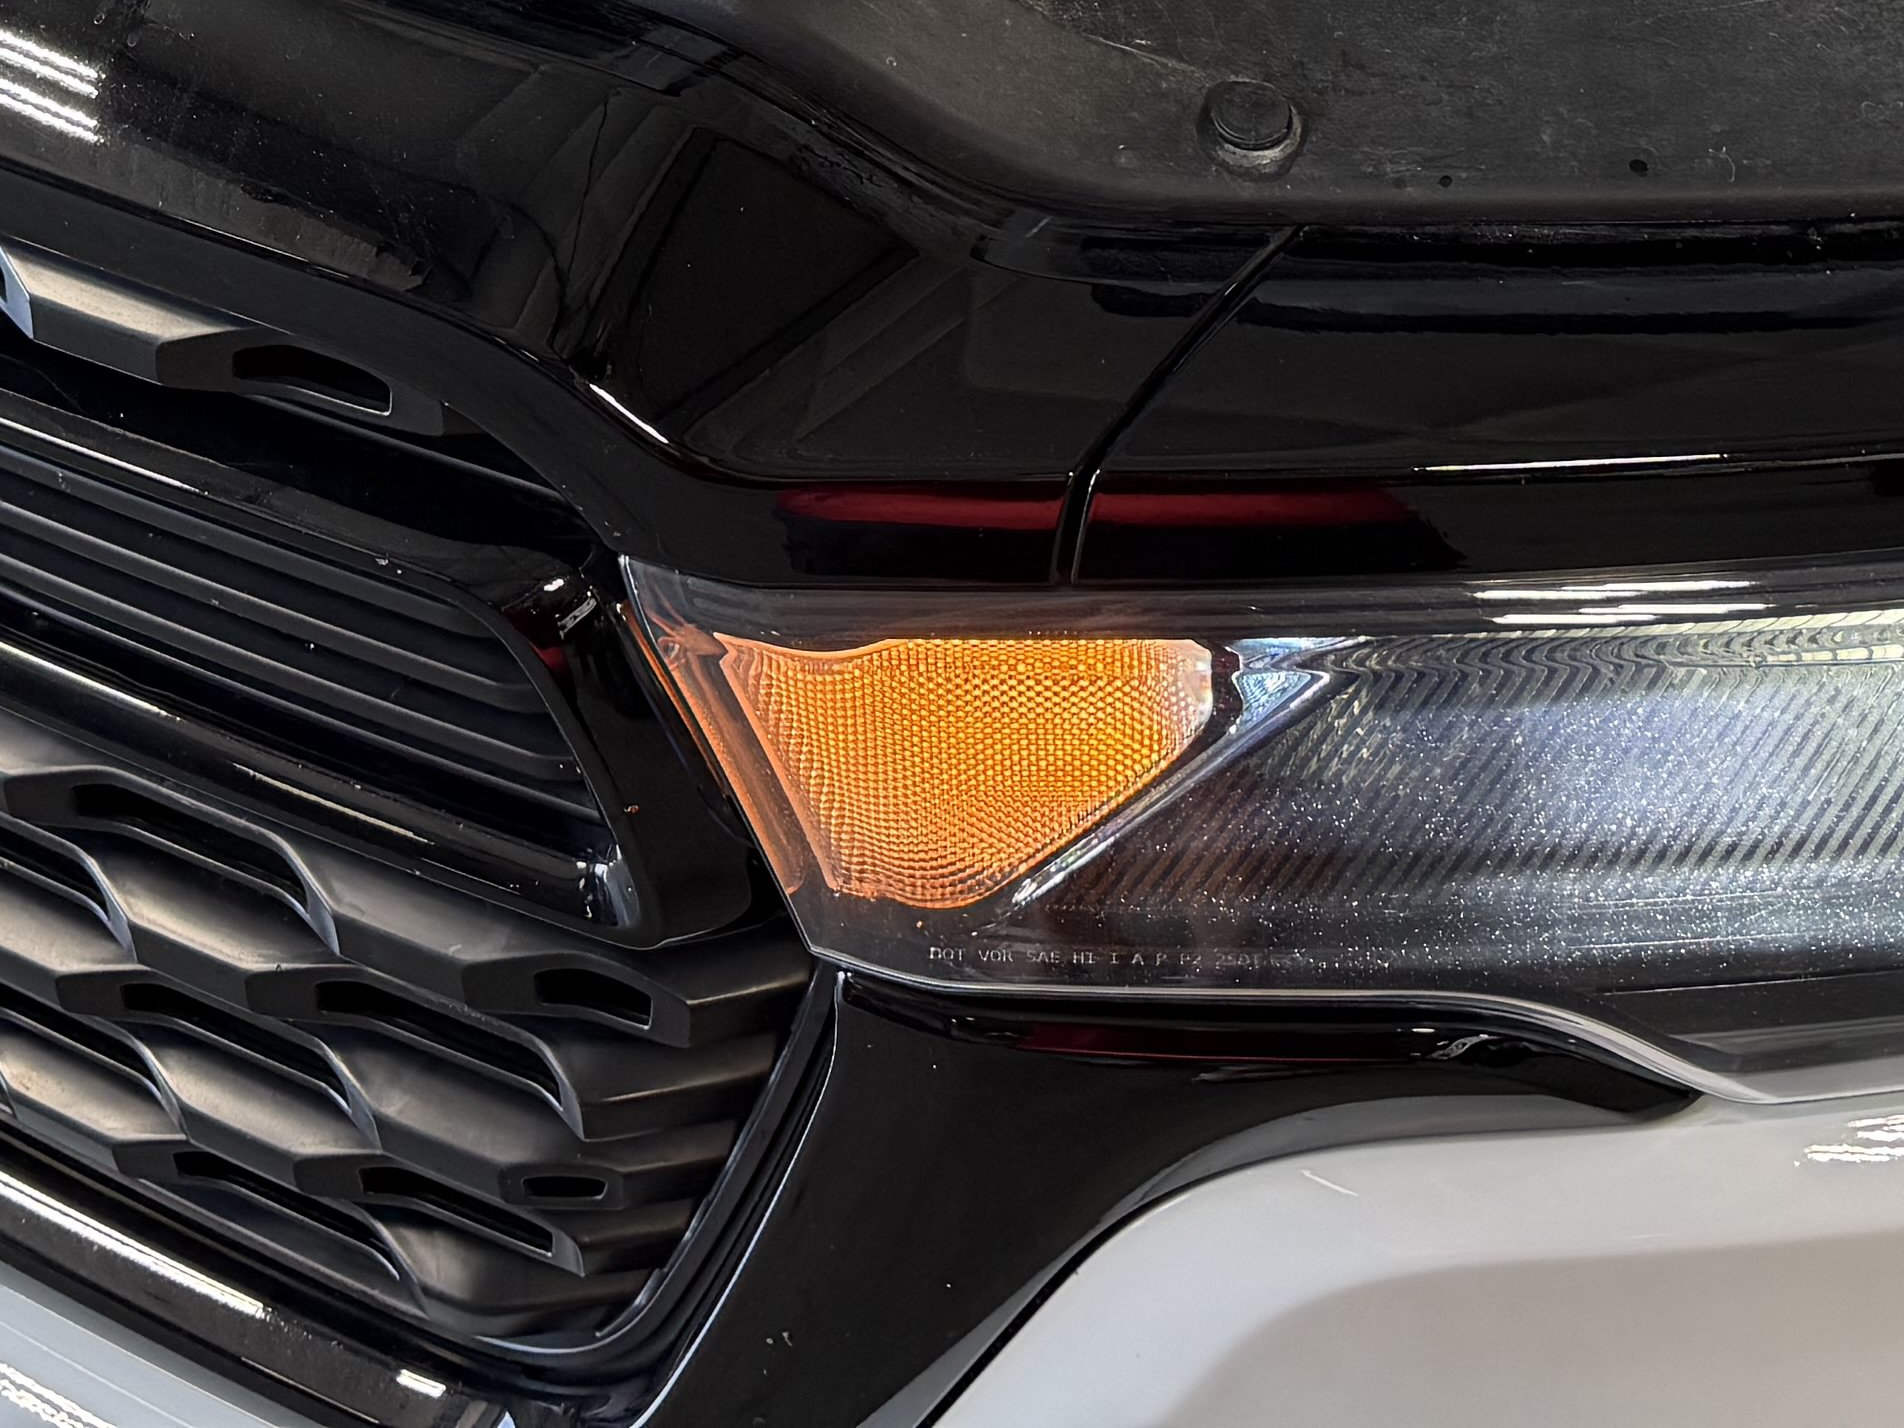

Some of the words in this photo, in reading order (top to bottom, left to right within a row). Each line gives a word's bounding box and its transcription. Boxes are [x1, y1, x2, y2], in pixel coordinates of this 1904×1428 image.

[929, 946, 965, 961] DOT
[978, 948, 1013, 962] VOR
[1026, 950, 1061, 963] SAE
